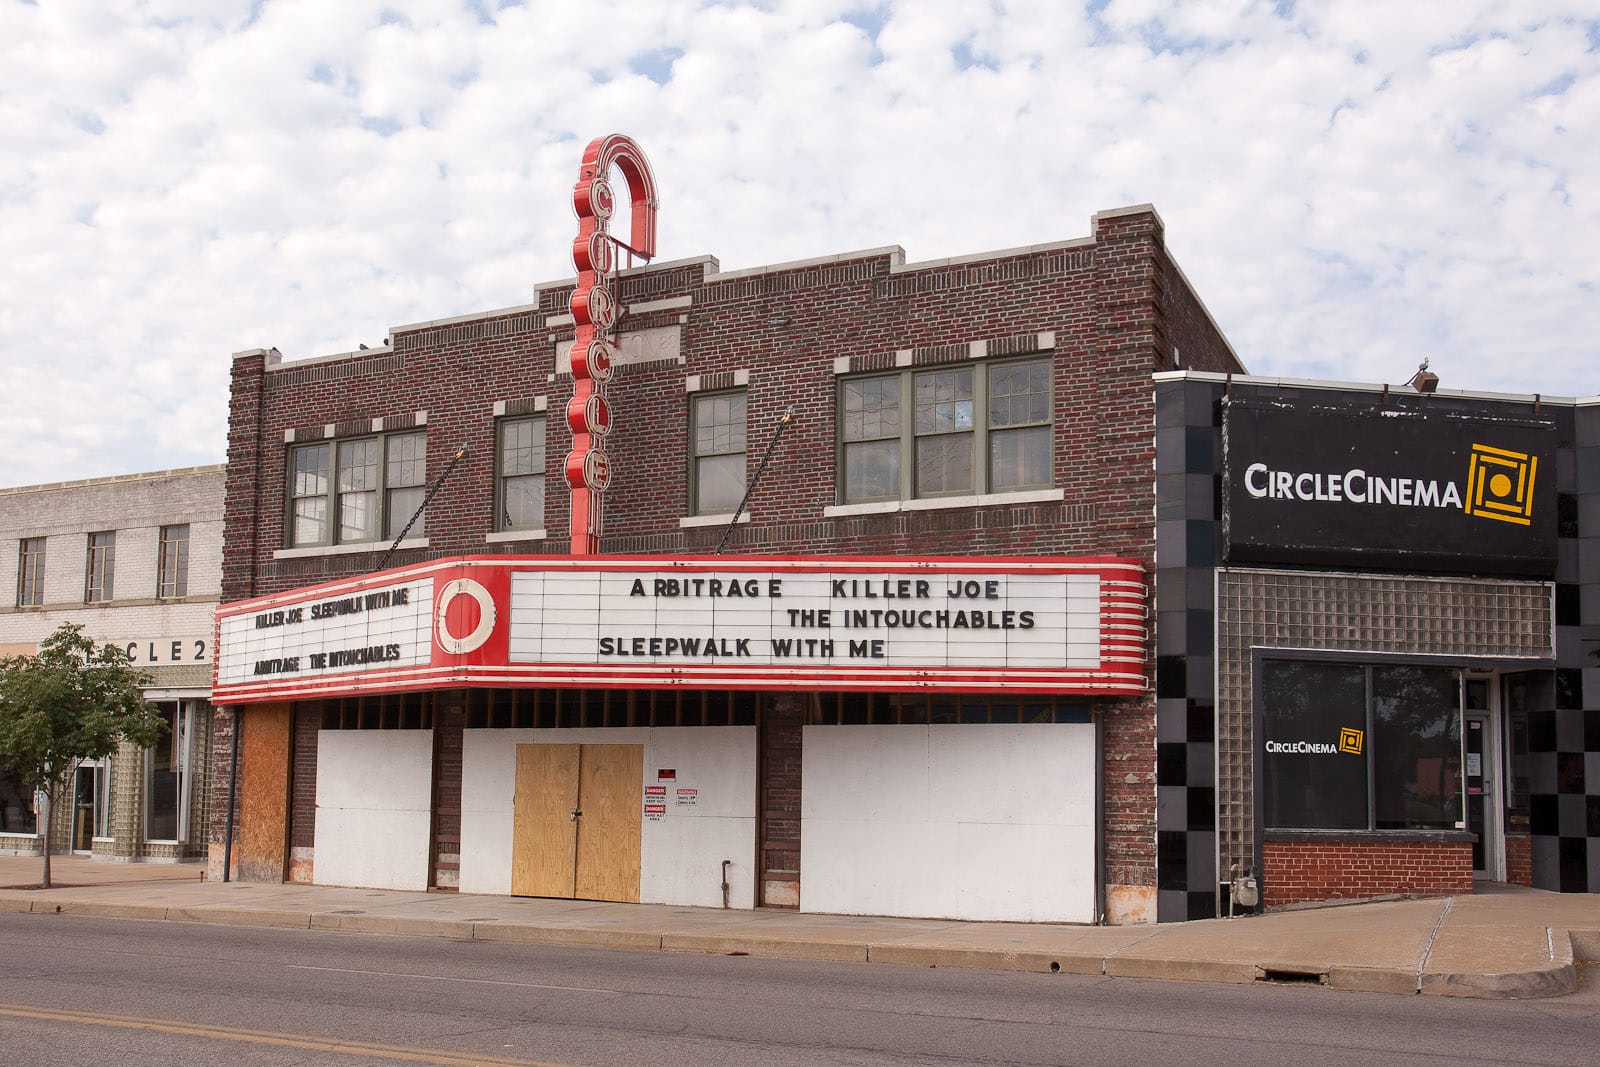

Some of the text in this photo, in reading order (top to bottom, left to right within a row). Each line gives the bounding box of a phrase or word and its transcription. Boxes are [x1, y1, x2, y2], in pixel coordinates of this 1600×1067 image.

[589, 181, 614, 490] CIRCLE
[832, 578, 930, 599] KILLER
[947, 578, 1000, 599] JOE
[255, 587, 409, 630] KILLER JOE SLEEPWALK WITH ME
[787, 609, 1036, 630] THE INTOUCHABLES
[253, 643, 400, 676] ARBITRAGE THE INTOUCHABLES
[599, 637, 885, 658] SLEEPWALK WITH ME
